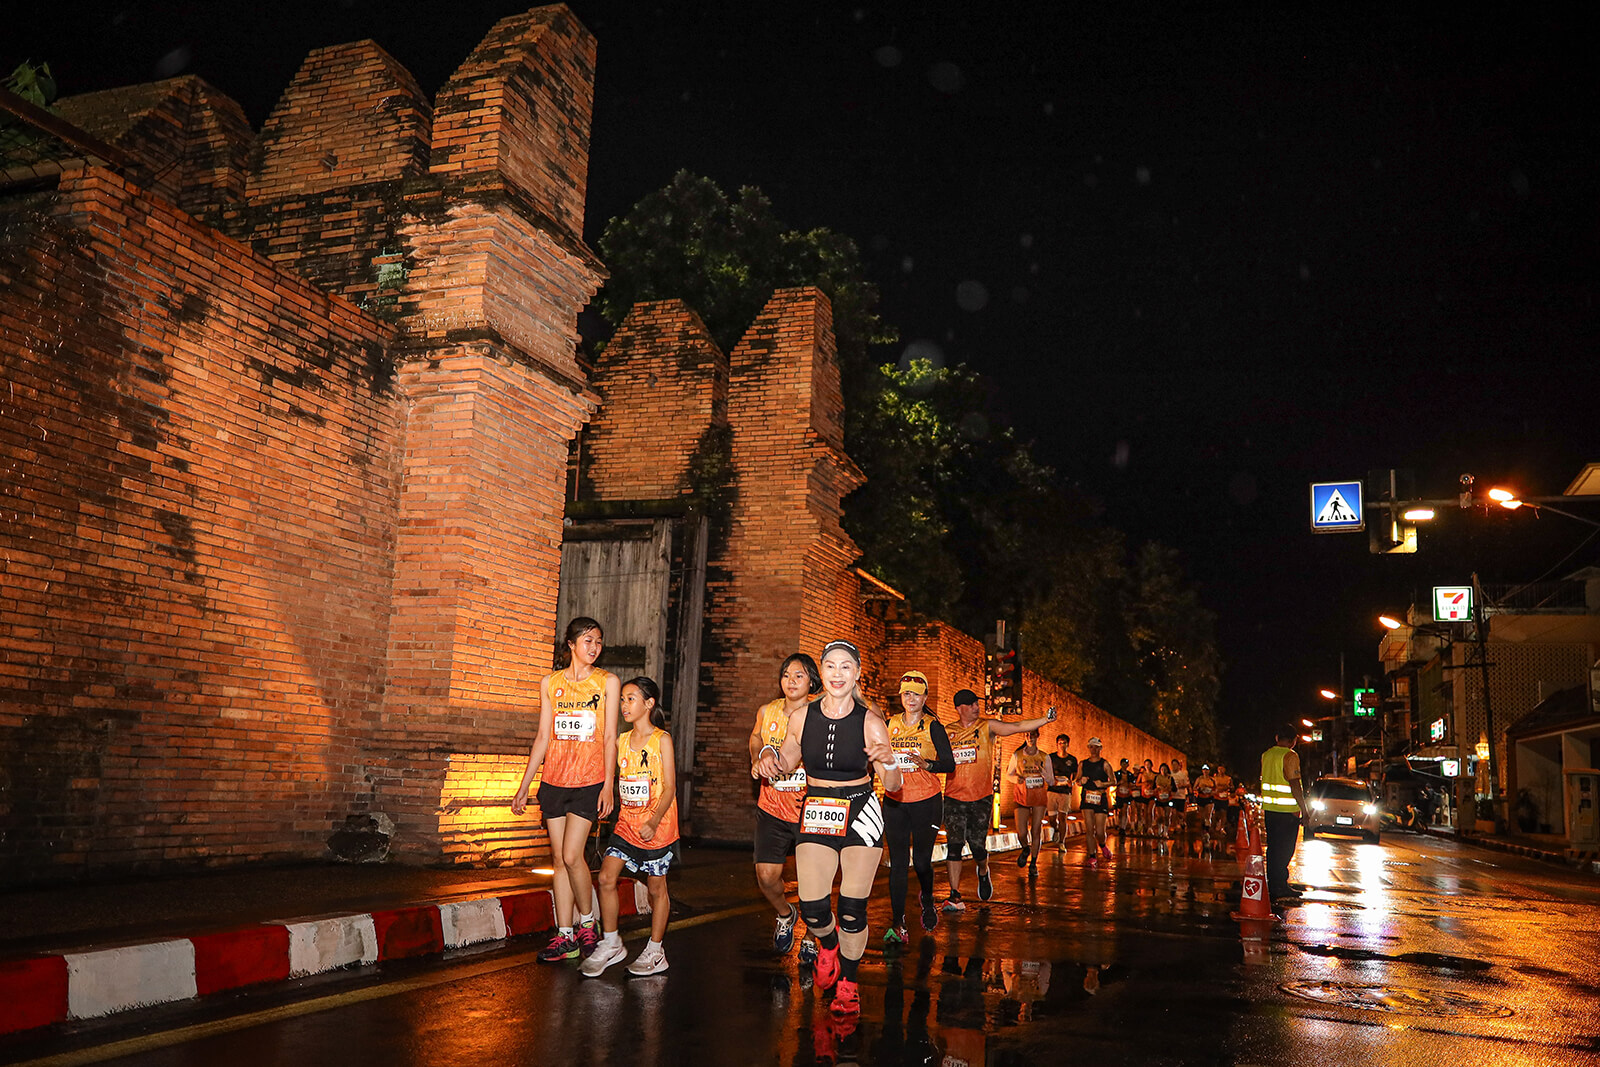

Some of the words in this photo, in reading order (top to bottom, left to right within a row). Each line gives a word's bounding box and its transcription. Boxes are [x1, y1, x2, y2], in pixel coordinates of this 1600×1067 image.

[556, 720, 592, 729] 1616
[891, 741, 922, 749] REEDOM
[805, 809, 845, 822] 501800
